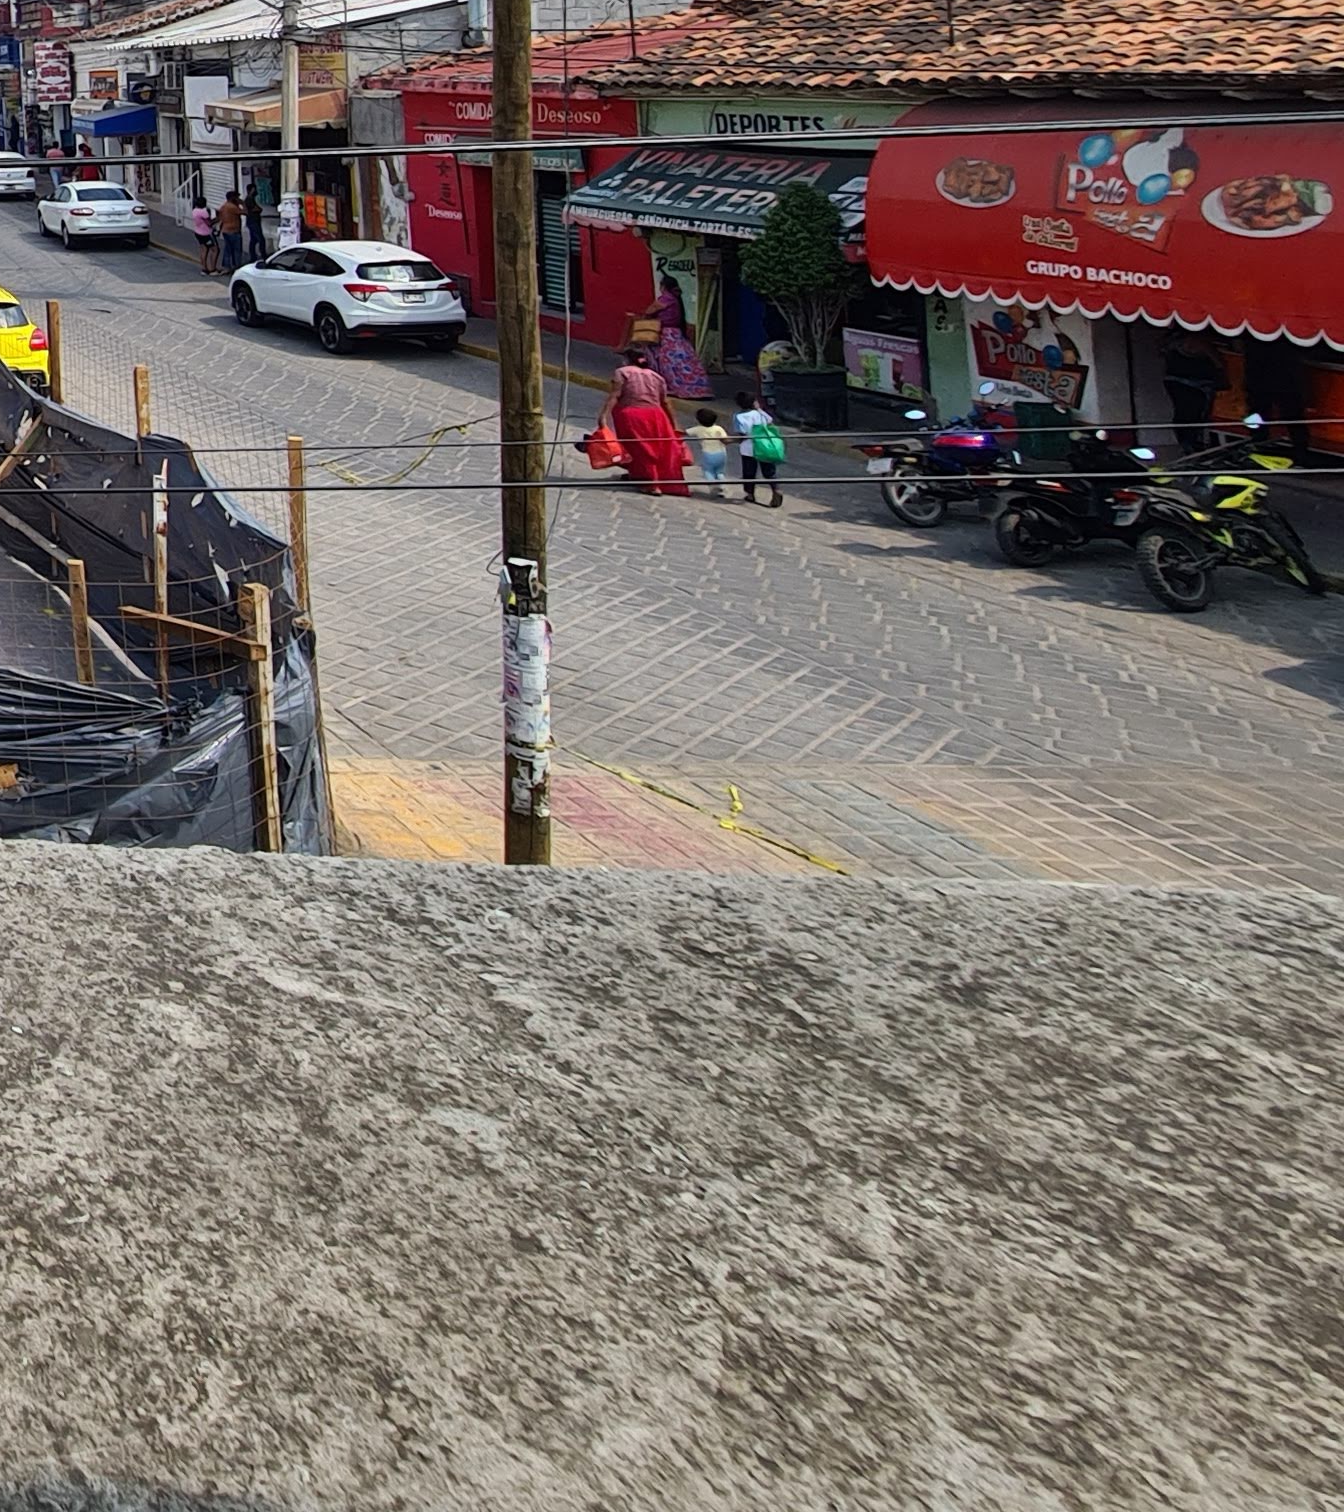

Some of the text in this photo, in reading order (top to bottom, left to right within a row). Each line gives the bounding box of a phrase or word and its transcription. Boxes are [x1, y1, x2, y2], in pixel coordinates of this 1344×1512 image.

[714, 112, 826, 134] DEPORTES
[627, 149, 831, 188] VINATERIA
[1066, 163, 1128, 204] Pollo
[613, 177, 780, 216] PALETER
[1026, 260, 1172, 290] GRUPO BACHOCO
[981, 329, 1036, 364] Pollo
